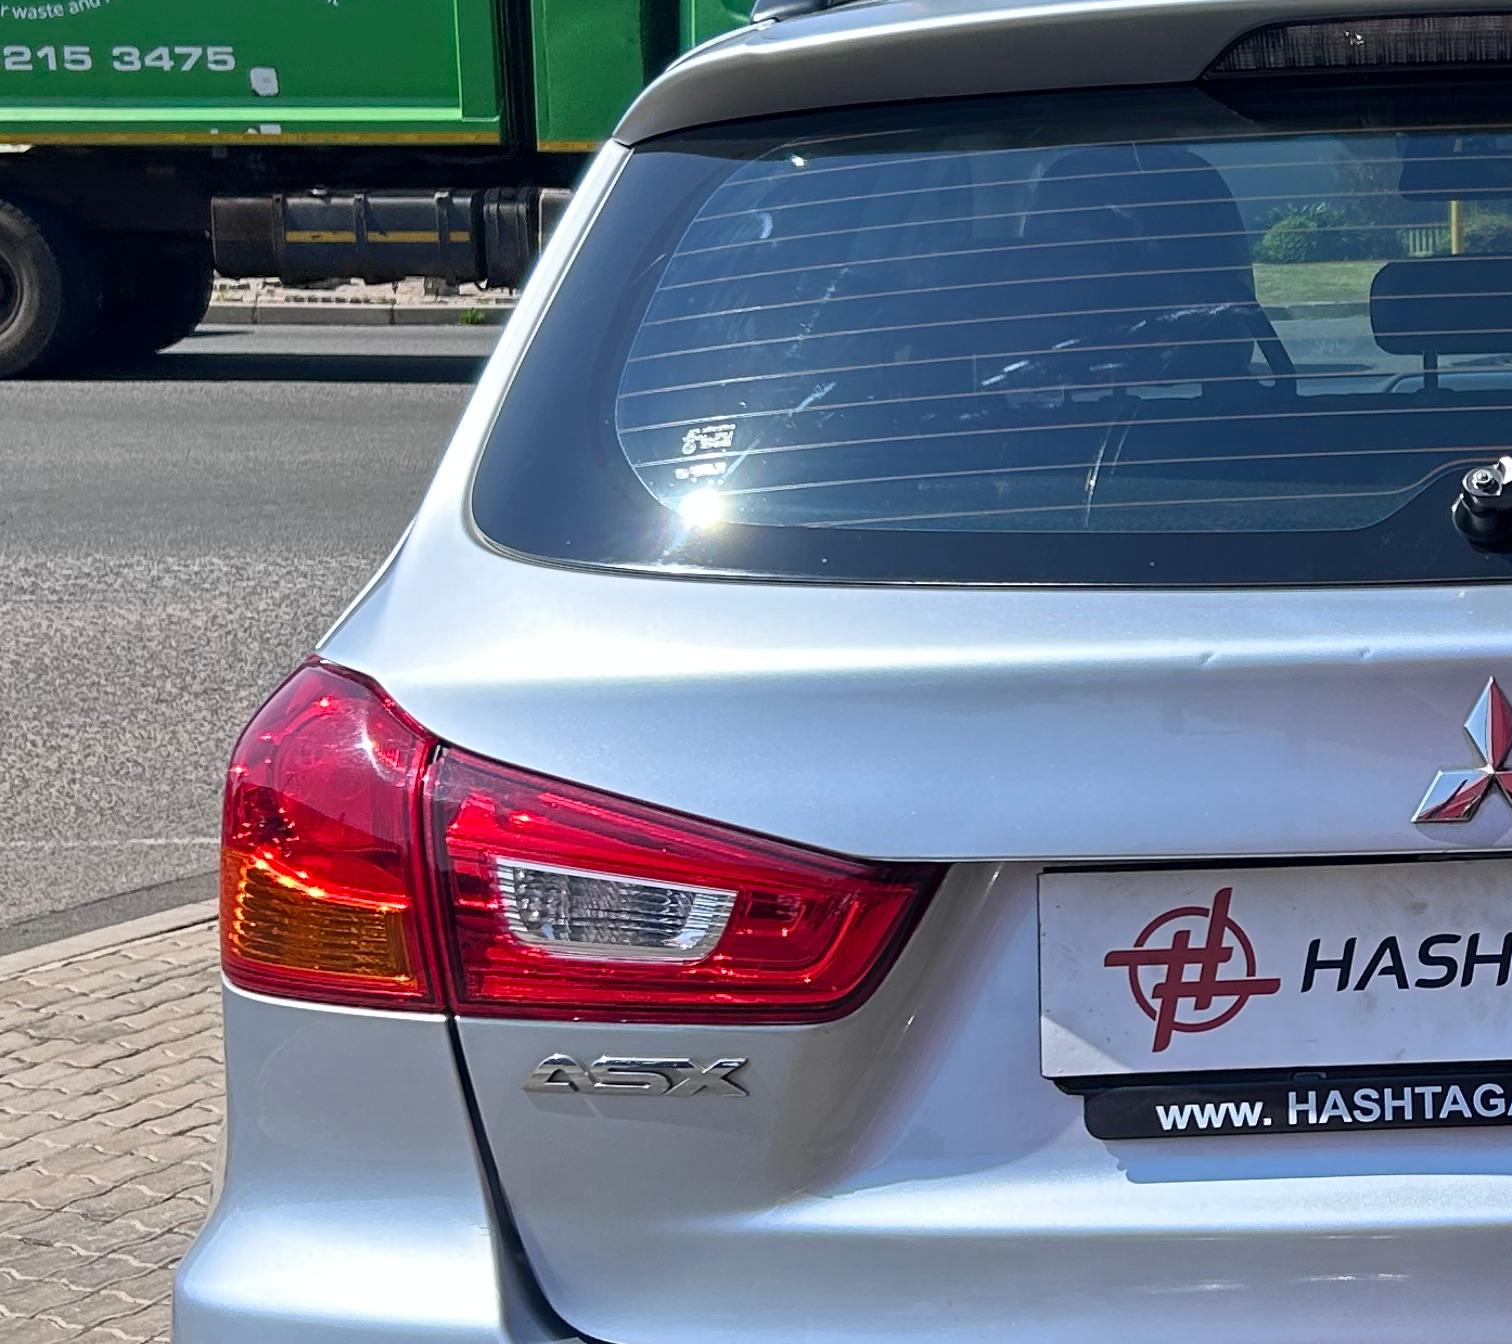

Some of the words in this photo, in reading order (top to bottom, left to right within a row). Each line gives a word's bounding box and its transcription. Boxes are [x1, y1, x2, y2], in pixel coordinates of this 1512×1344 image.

[12, 3, 65, 20] waste
[3, 45, 93, 72] 215
[112, 45, 237, 72] 3475
[522, 1053, 750, 1098] ASX
[1155, 1101, 1273, 1132] www.
